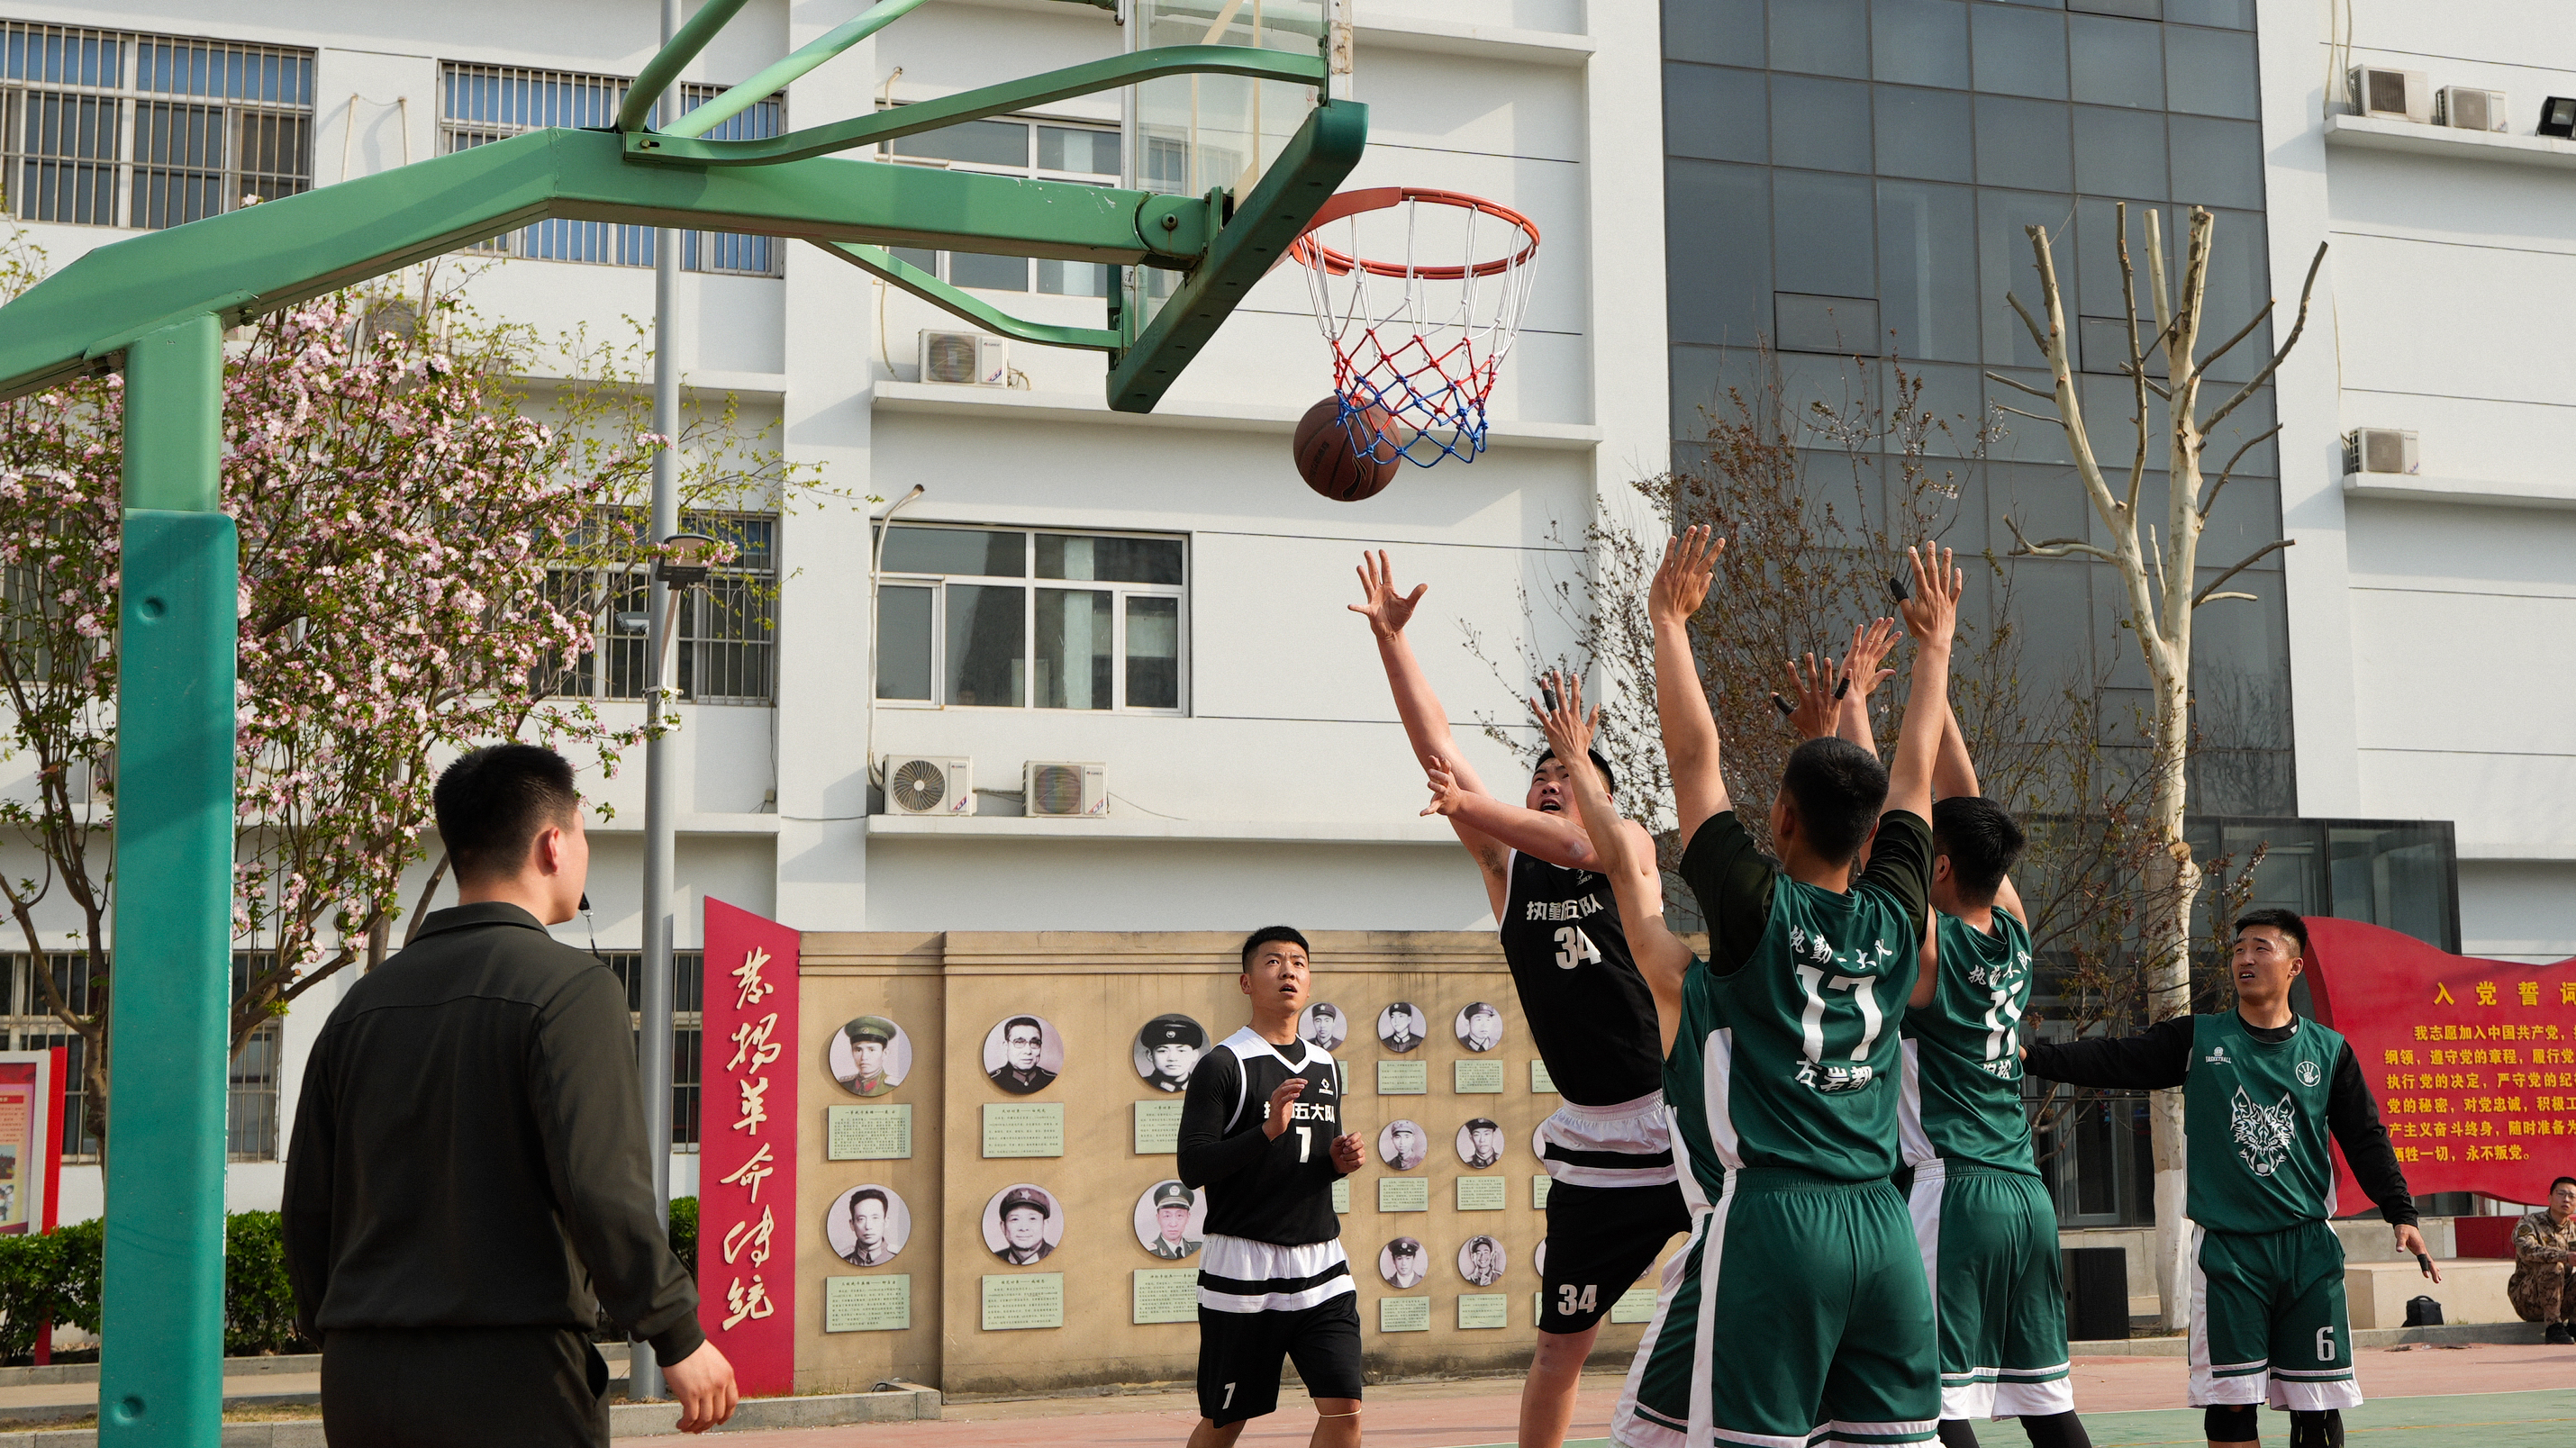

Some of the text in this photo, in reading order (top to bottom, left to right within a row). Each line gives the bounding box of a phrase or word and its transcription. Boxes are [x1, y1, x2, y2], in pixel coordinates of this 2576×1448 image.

[1554, 926, 1601, 970] 34
[1796, 964, 1882, 1063] 17
[2415, 1025, 2576, 1041] 我志愿加入中国共产党，
[2386, 1072, 2576, 1090] 执行党的决定，严守党的纪
[1557, 1283, 1598, 1316] 34
[2316, 1326, 2336, 1362] 6
